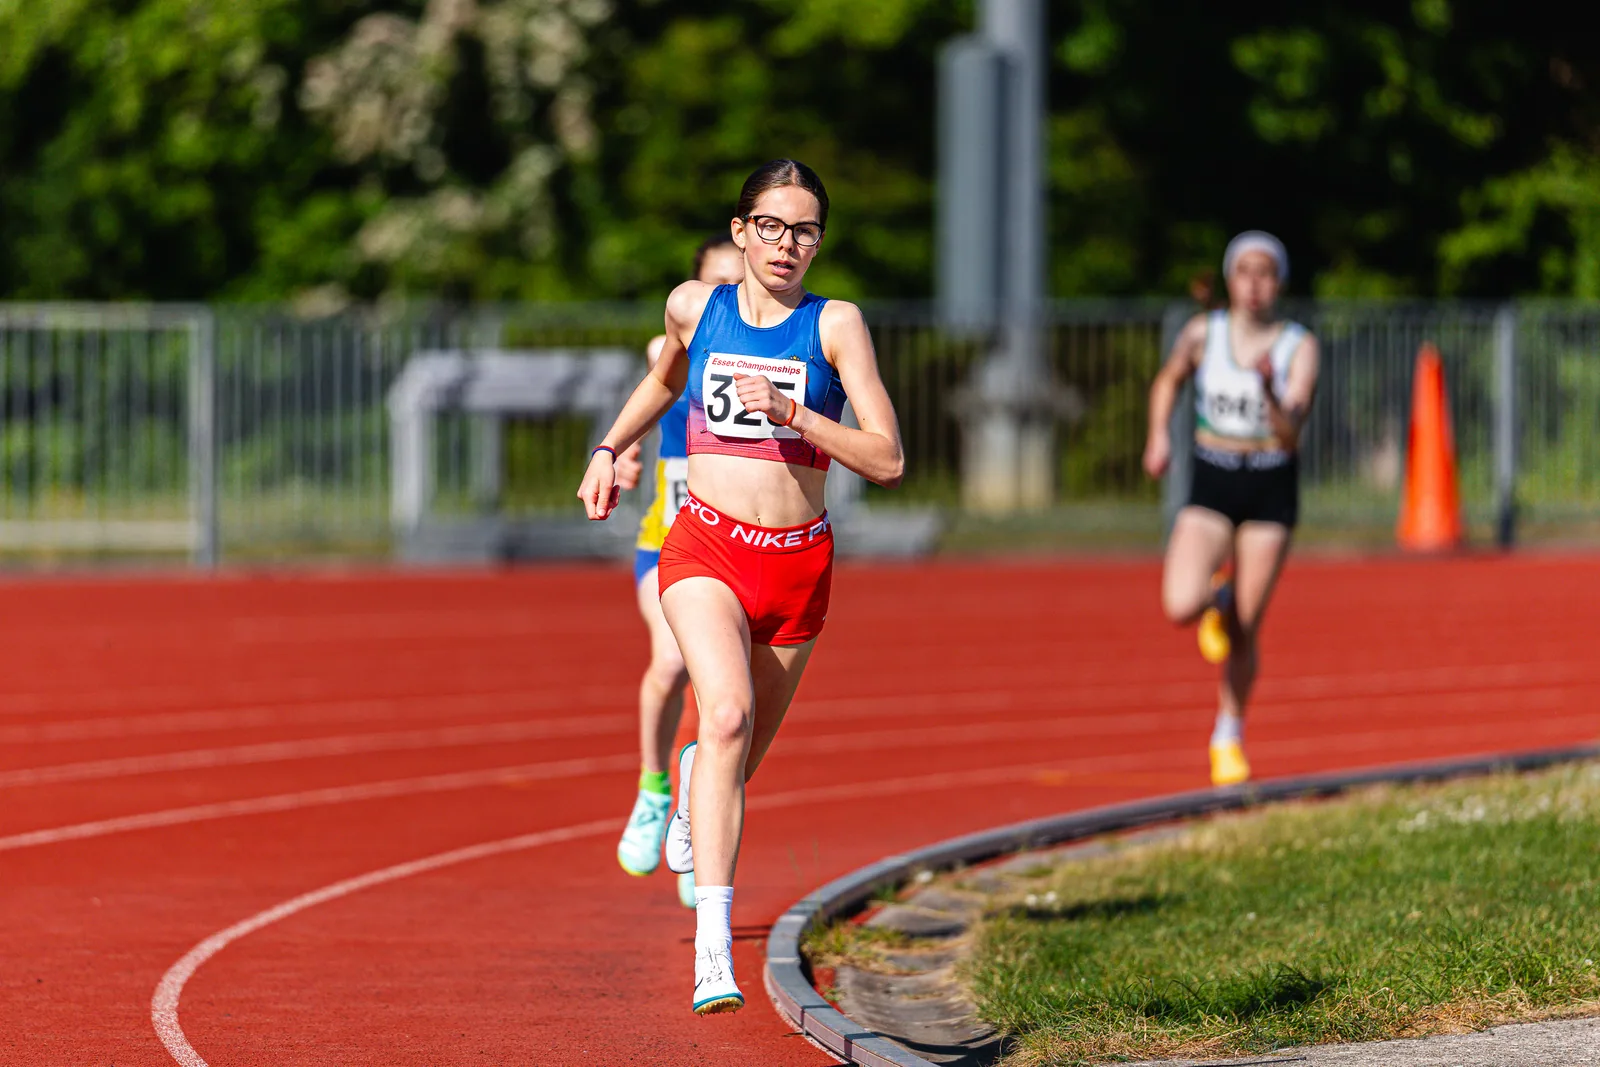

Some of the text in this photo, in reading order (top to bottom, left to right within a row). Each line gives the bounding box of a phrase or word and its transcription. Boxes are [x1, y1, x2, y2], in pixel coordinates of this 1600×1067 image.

[711, 357, 801, 375] Essex Championships
[730, 524, 804, 548] NIKE
